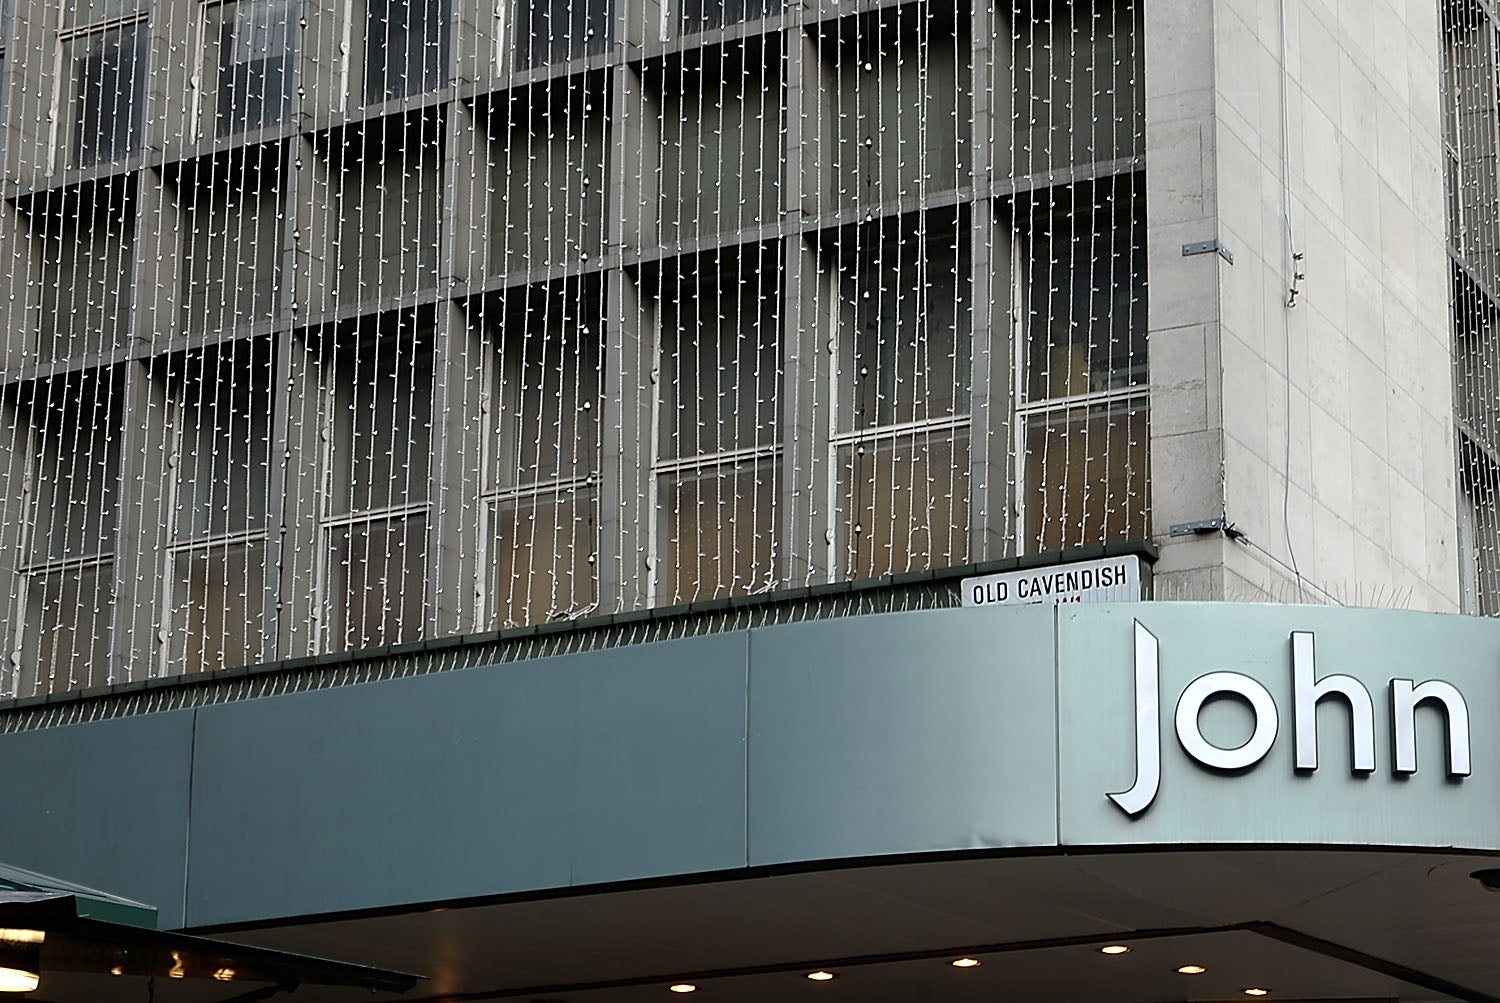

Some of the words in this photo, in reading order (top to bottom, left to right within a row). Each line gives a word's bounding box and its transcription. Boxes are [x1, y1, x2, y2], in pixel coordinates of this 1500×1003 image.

[973, 581, 1008, 605] OLD
[1017, 564, 1127, 600] CAVENDISH
[1105, 617, 1473, 821] John
